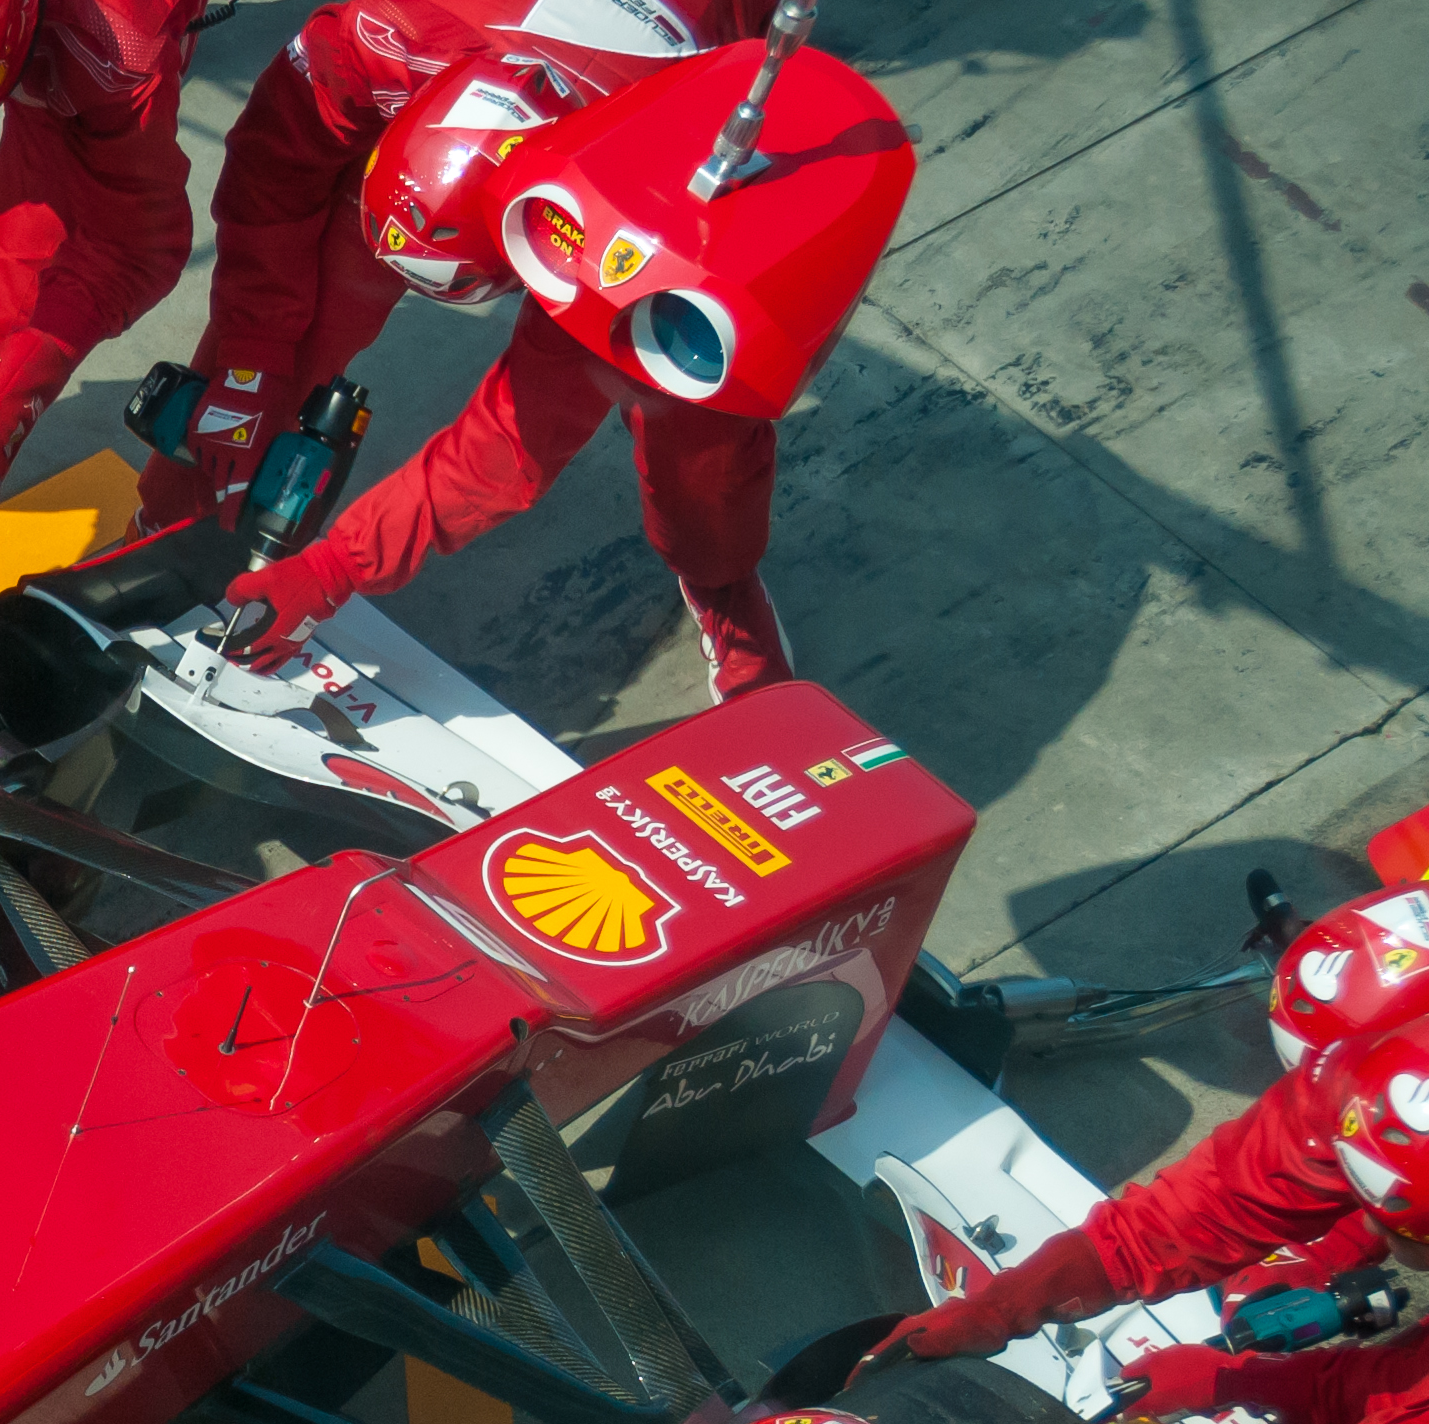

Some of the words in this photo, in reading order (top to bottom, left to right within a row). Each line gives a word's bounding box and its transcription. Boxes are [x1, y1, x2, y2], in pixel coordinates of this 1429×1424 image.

[542, 205, 585, 248] BRAK
[550, 235, 573, 256] ON
[664, 779, 776, 866] PIRELLI
[720, 764, 823, 831] FIAT
[604, 798, 746, 908] KASPERSKY
[677, 902, 881, 1037] KASPERSKY
[755, 1011, 840, 1046] WORLD
[642, 1078, 723, 1120] Abu
[730, 1032, 836, 1092] Dhabi
[130, 1210, 328, 1368] Santander
